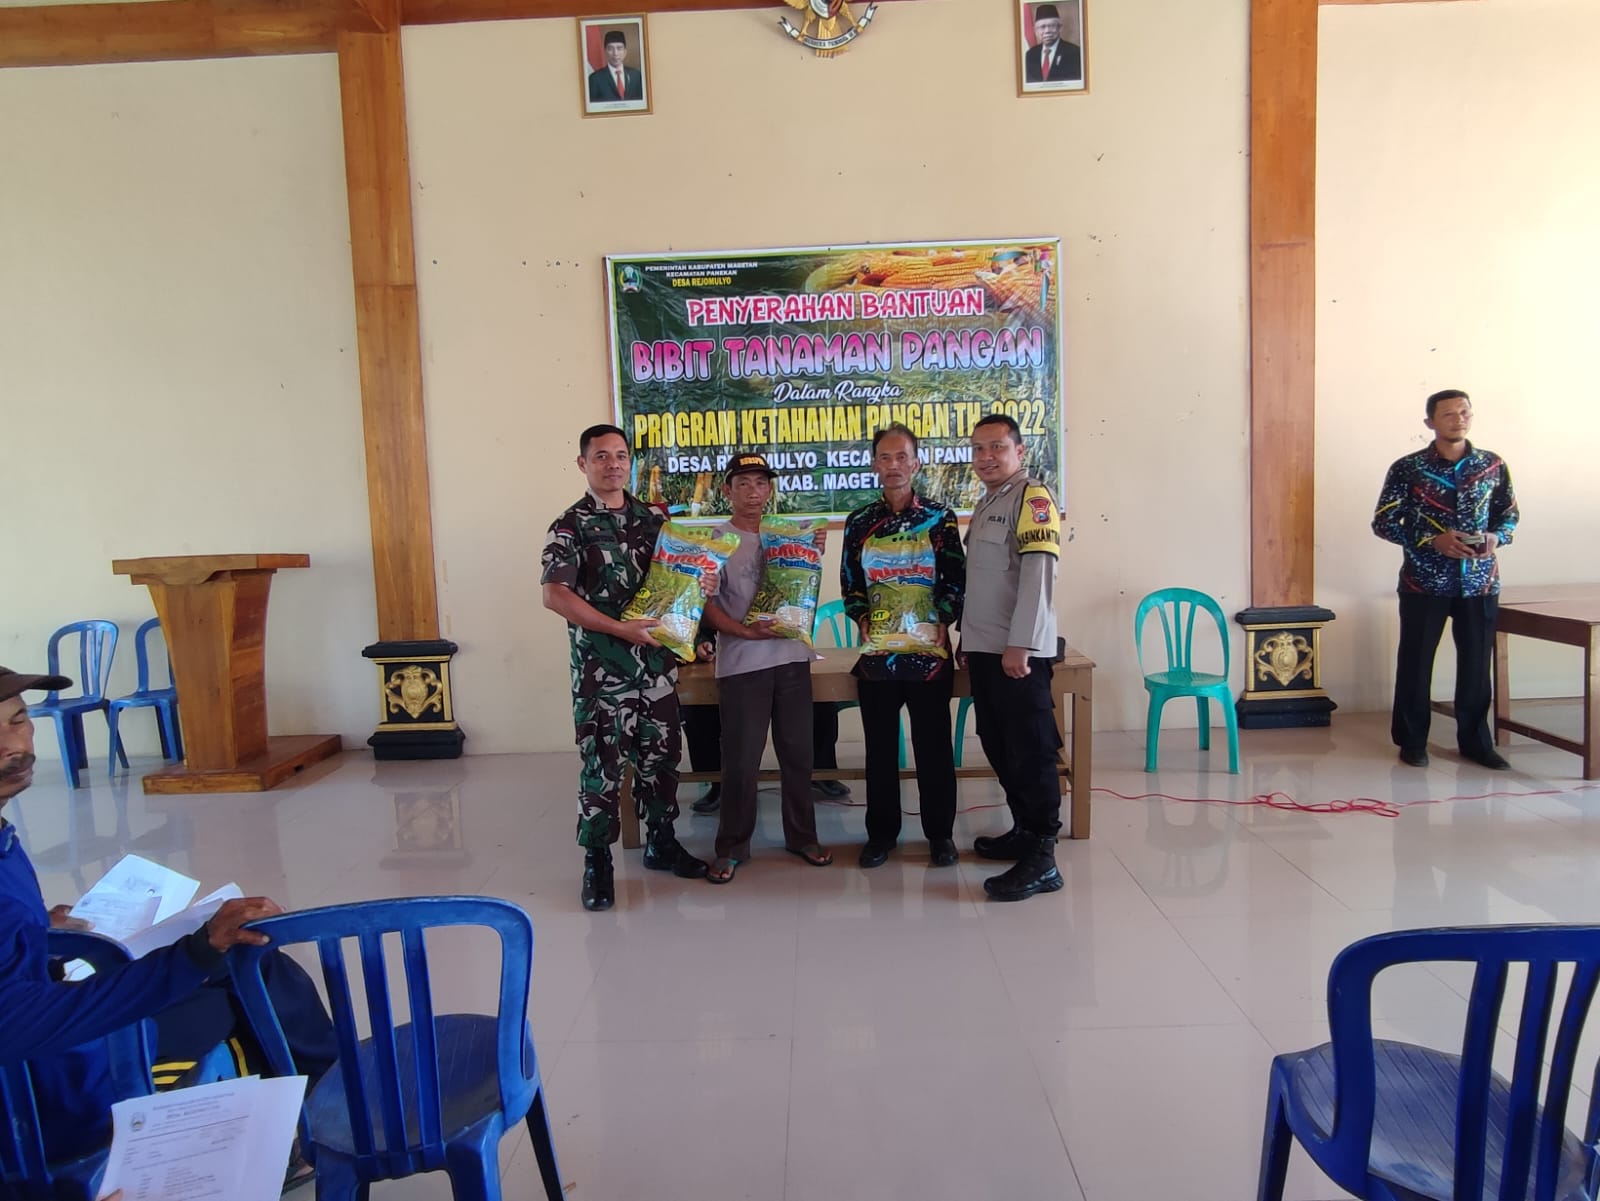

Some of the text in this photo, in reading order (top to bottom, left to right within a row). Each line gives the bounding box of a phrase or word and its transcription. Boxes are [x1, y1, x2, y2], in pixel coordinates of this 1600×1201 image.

[688, 263, 726, 271] KABUPATEN
[672, 277, 732, 287] DESA REJOMULYO
[686, 288, 985, 327] PENYERAHAN BANTUAN
[631, 326, 1044, 383] BIBIT TANAMAN PANGAN
[774, 380, 903, 404] Dalam Rangka
[634, 410, 737, 449] PROGRAM
[741, 405, 862, 445] KETAHANAN
[668, 456, 714, 473] DESA
[716, 452, 817, 472] RMULYO
[779, 472, 884, 492] KAB. MAGET
